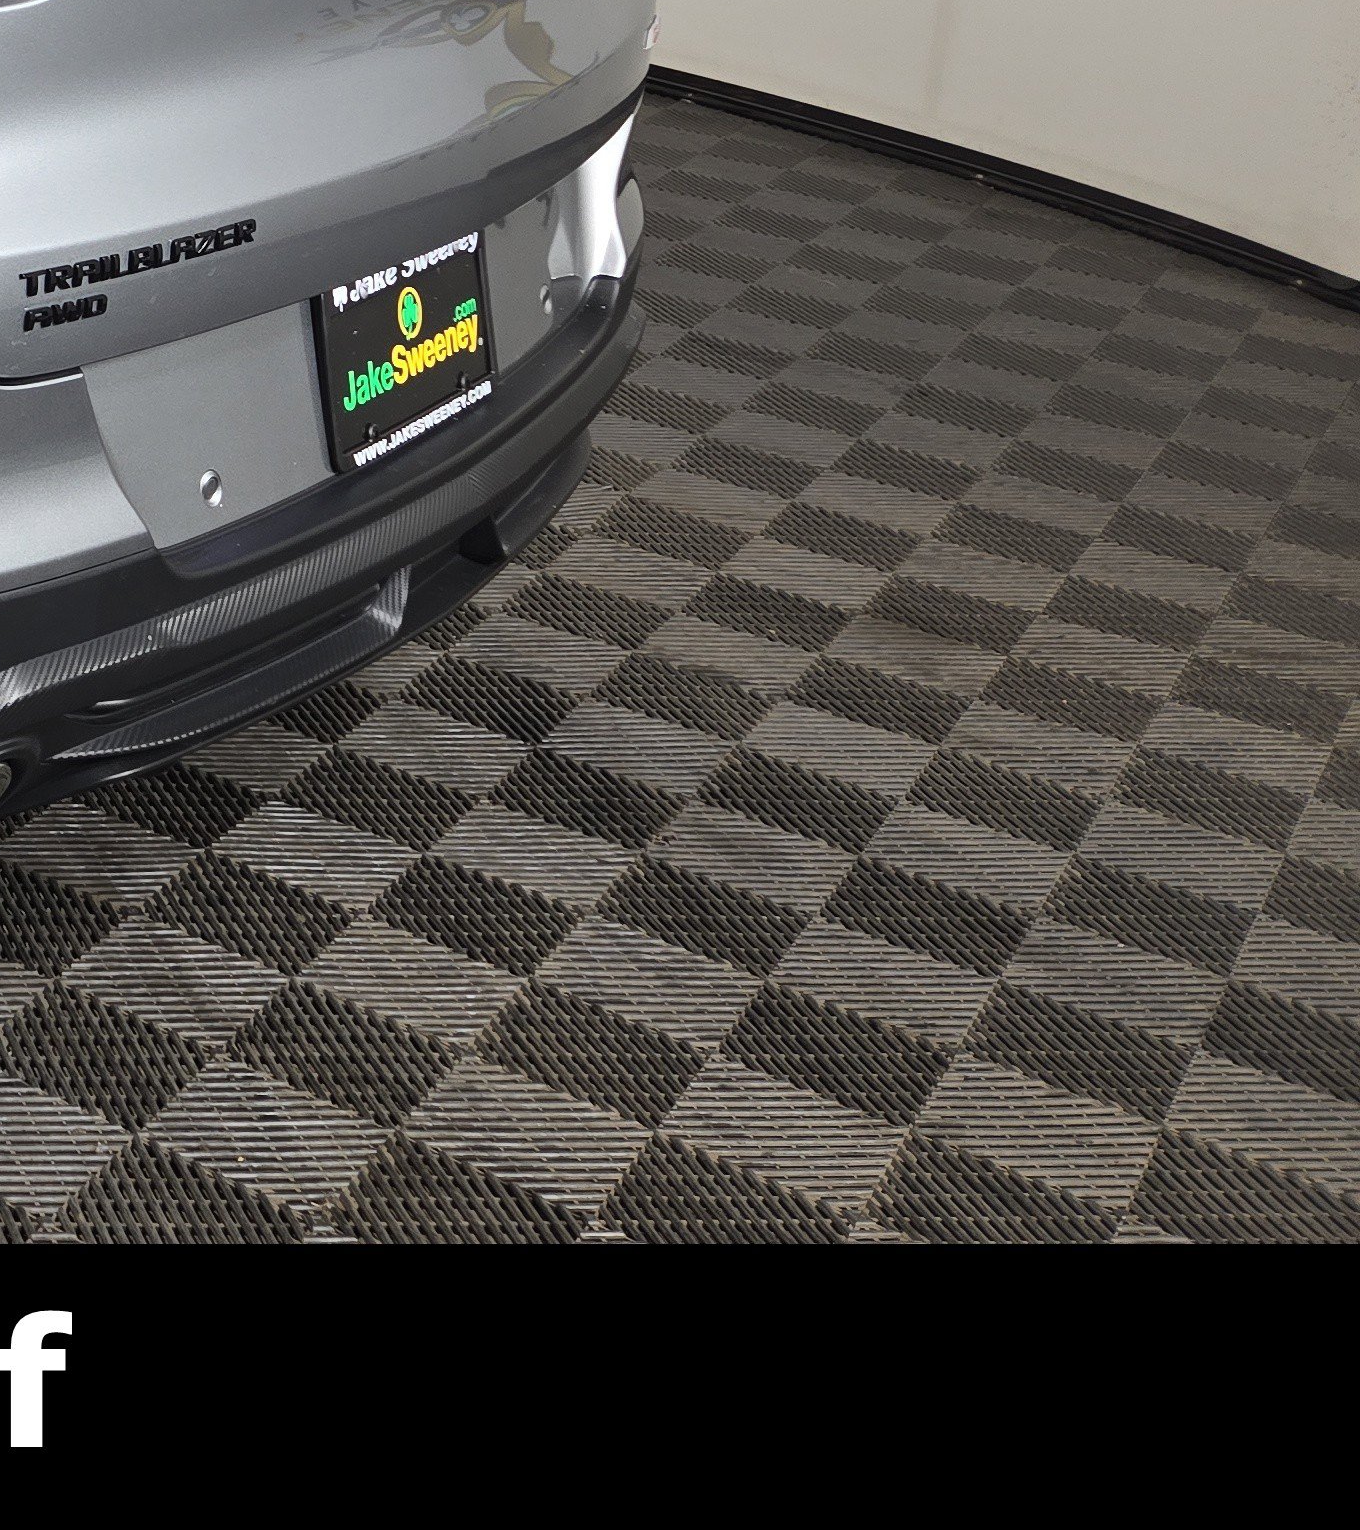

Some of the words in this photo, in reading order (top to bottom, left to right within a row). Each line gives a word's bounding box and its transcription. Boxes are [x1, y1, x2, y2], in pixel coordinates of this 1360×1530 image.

[18, 218, 257, 298] TRAILBLAZER
[23, 293, 108, 333] AWD
[352, 380, 493, 467] WWW.JAKESWEENEY.COM
